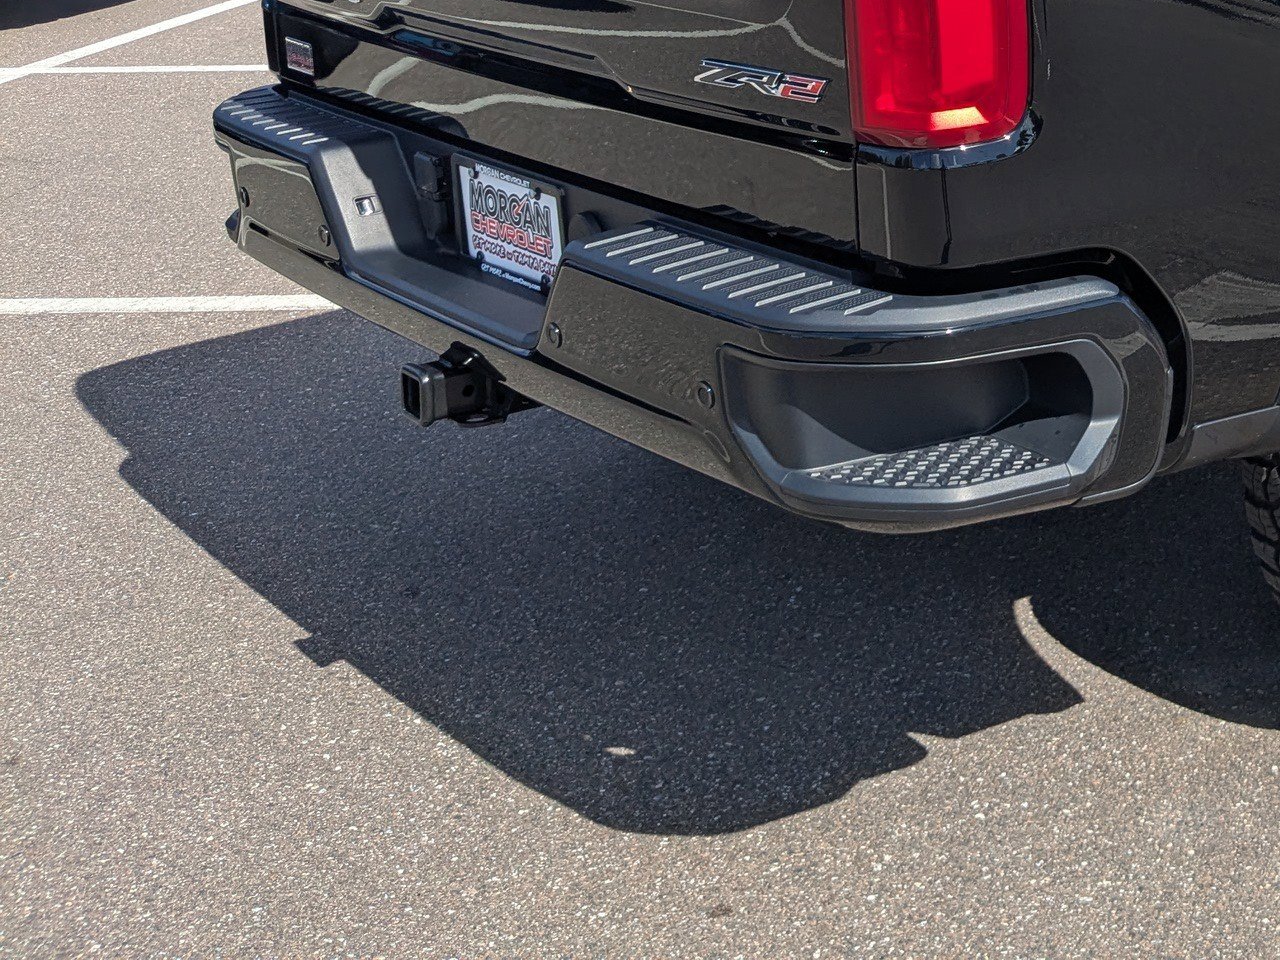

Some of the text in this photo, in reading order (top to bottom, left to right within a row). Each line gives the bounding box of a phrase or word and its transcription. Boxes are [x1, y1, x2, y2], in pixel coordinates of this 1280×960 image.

[693, 57, 832, 104] ZR2
[475, 162, 500, 179] MORGAN
[469, 178, 552, 239] MORGAN
[471, 210, 553, 259] CHEVROLET
